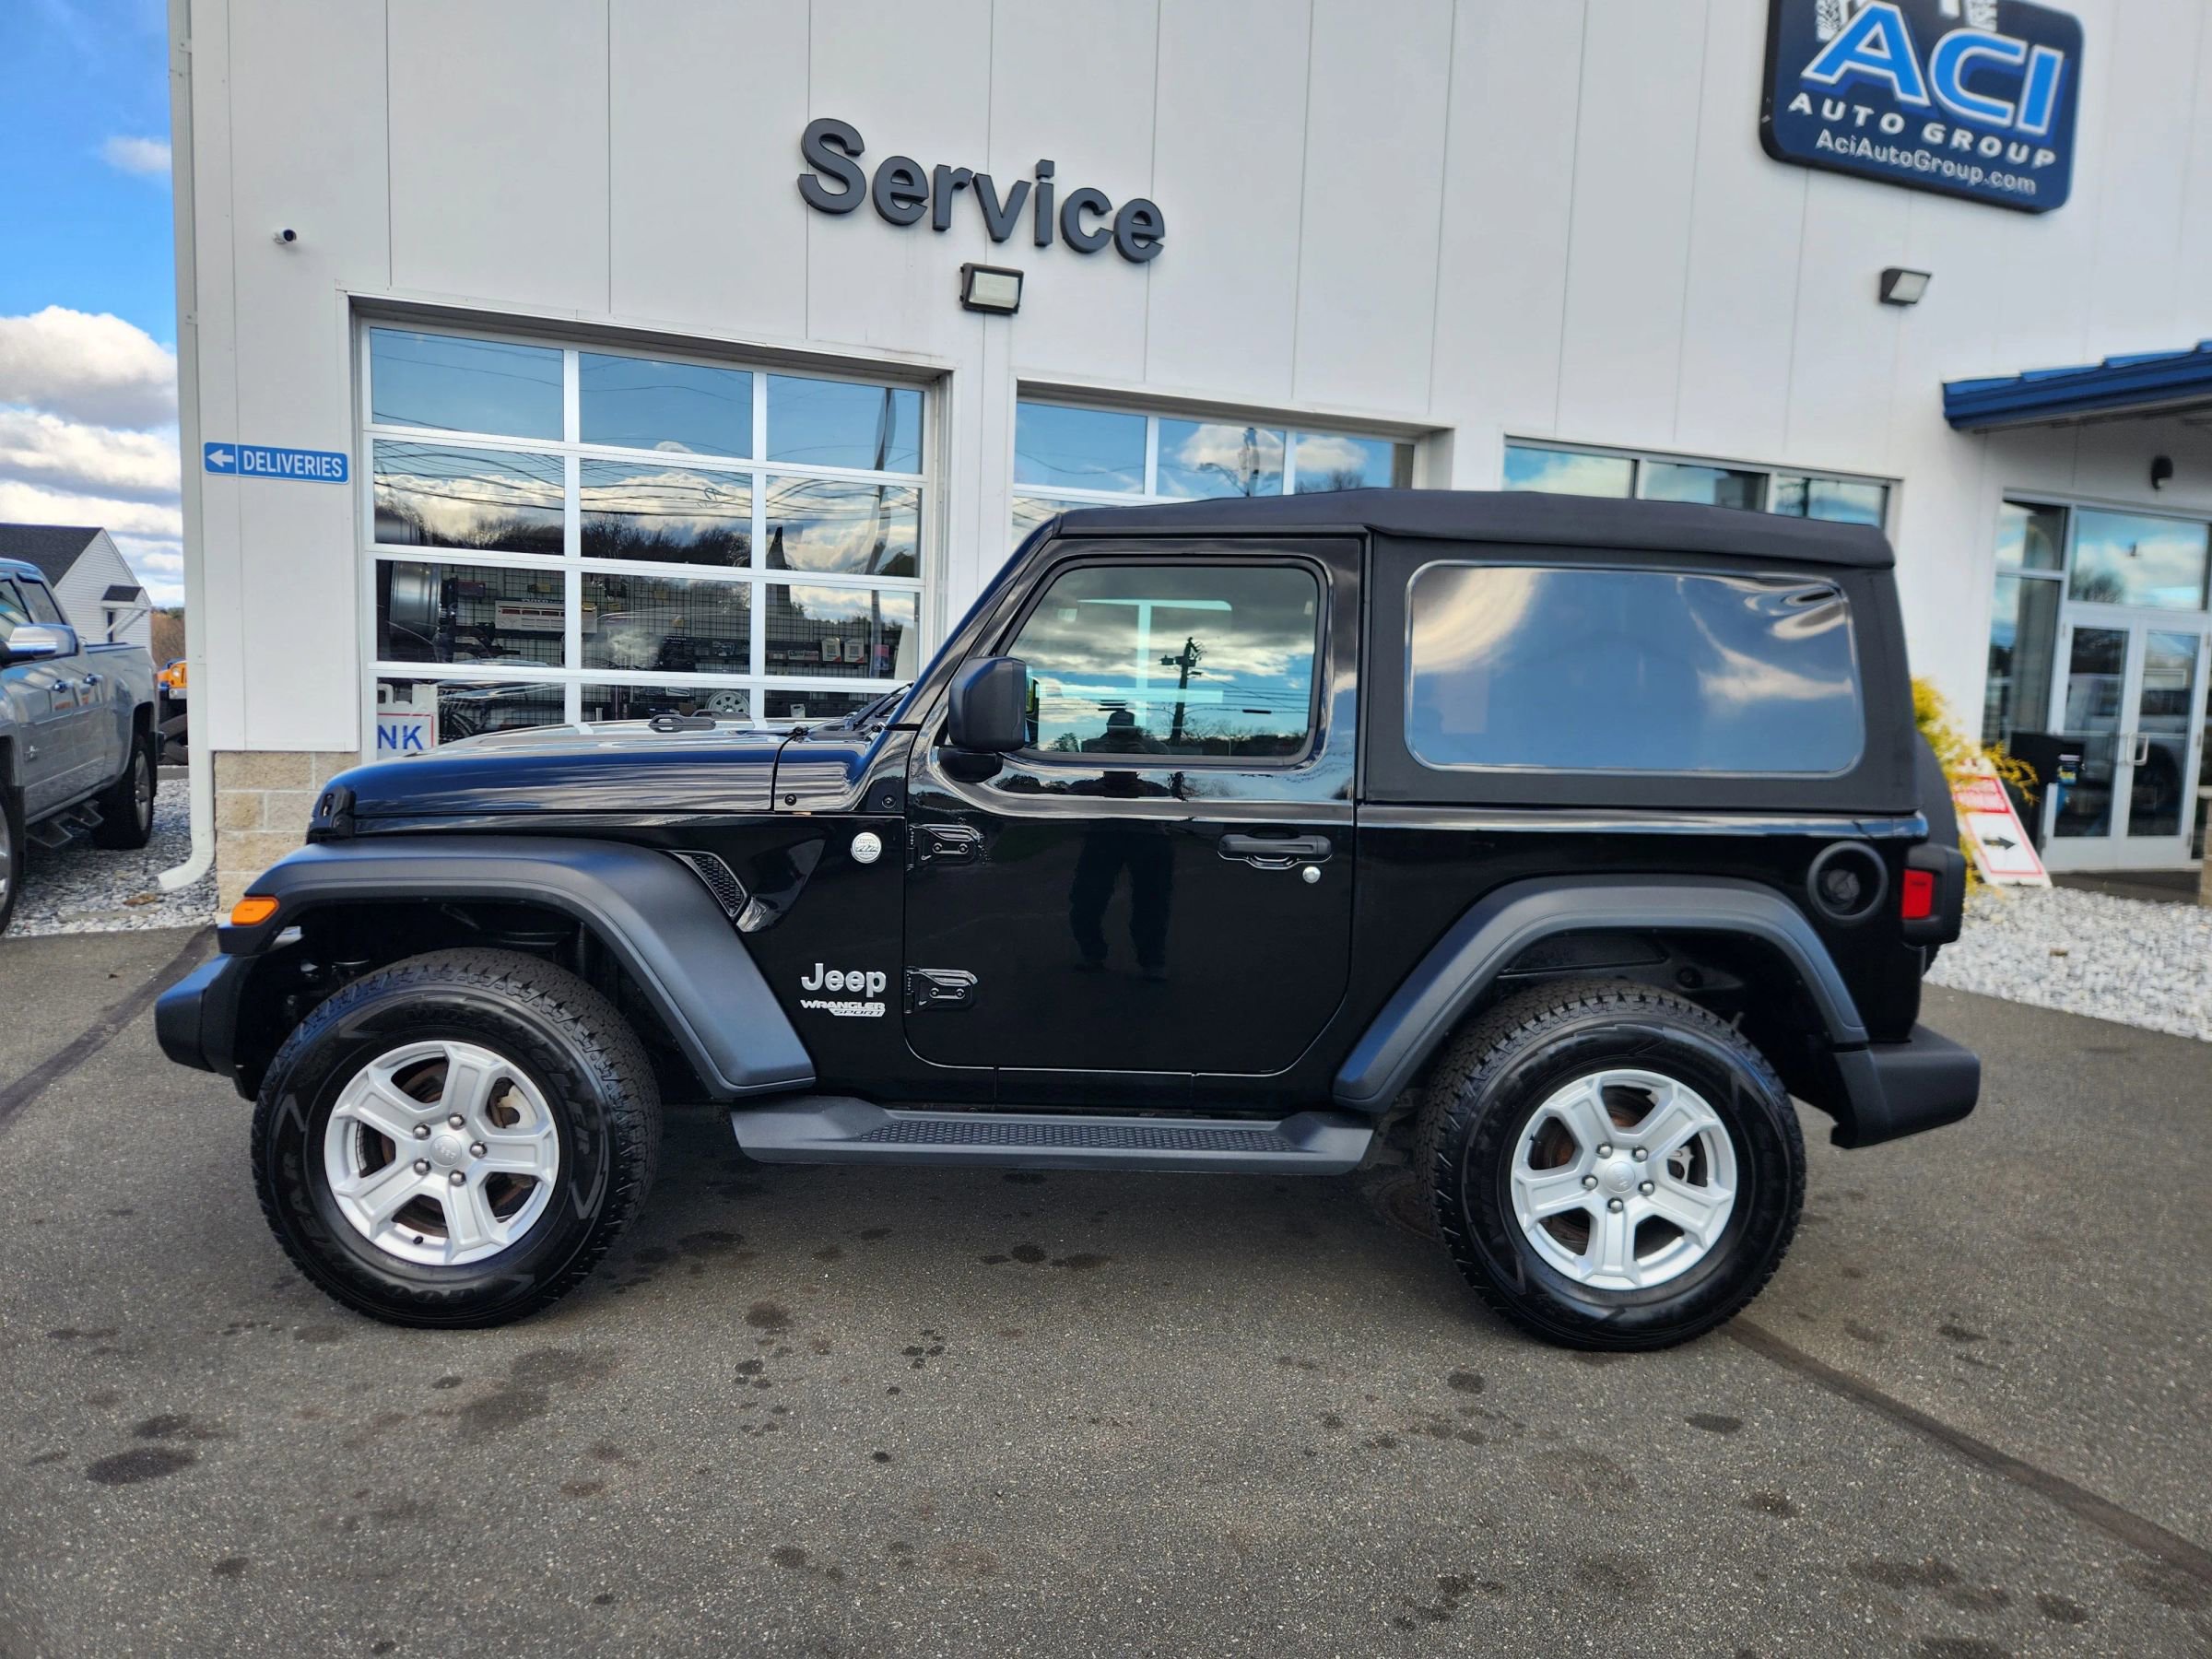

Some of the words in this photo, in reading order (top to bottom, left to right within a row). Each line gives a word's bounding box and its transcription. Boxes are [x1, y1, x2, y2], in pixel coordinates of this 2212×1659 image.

[1800, 0, 2065, 135] ACI
[1788, 92, 1906, 135] AUTO
[1922, 122, 2057, 169] GROUP
[1815, 128, 2037, 196] AciAutoGroup.com
[796, 117, 1166, 264] Service
[242, 450, 343, 478] DELIVERIES
[799, 999, 886, 1010] WRANGLER
[800, 962, 887, 998] Jeep
